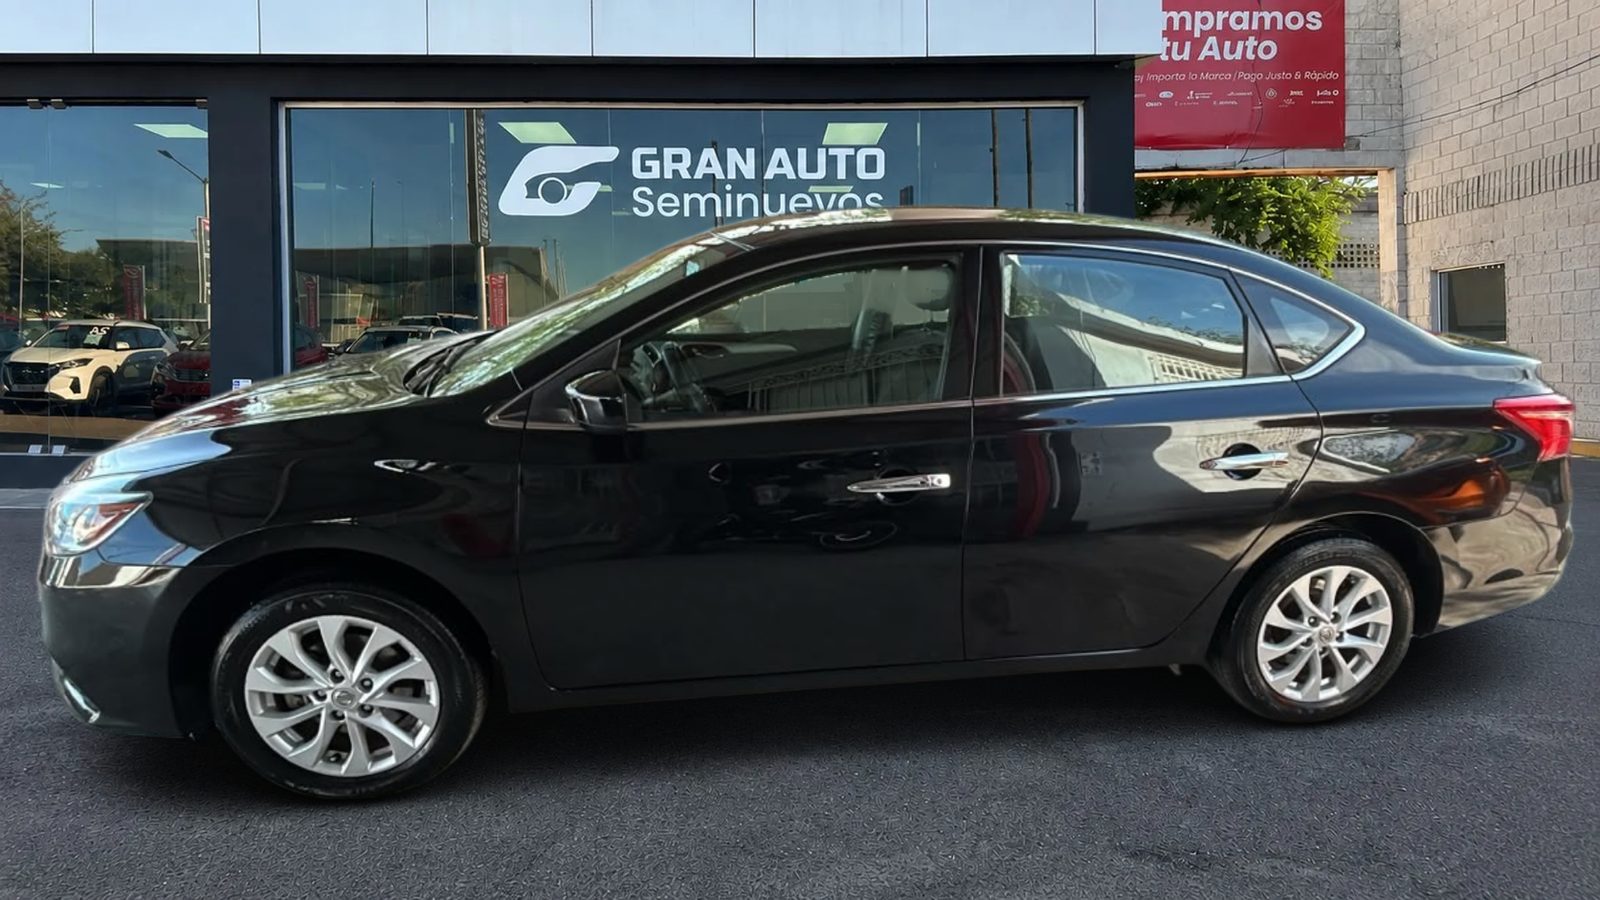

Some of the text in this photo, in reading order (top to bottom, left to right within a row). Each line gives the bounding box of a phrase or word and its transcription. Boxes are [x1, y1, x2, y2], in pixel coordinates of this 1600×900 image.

[1160, 36, 1278, 61] tu Auto
[1265, 71, 1292, 81] Justo
[631, 147, 886, 180] GRAN AUTO
[632, 183, 884, 218] Seminuevos
